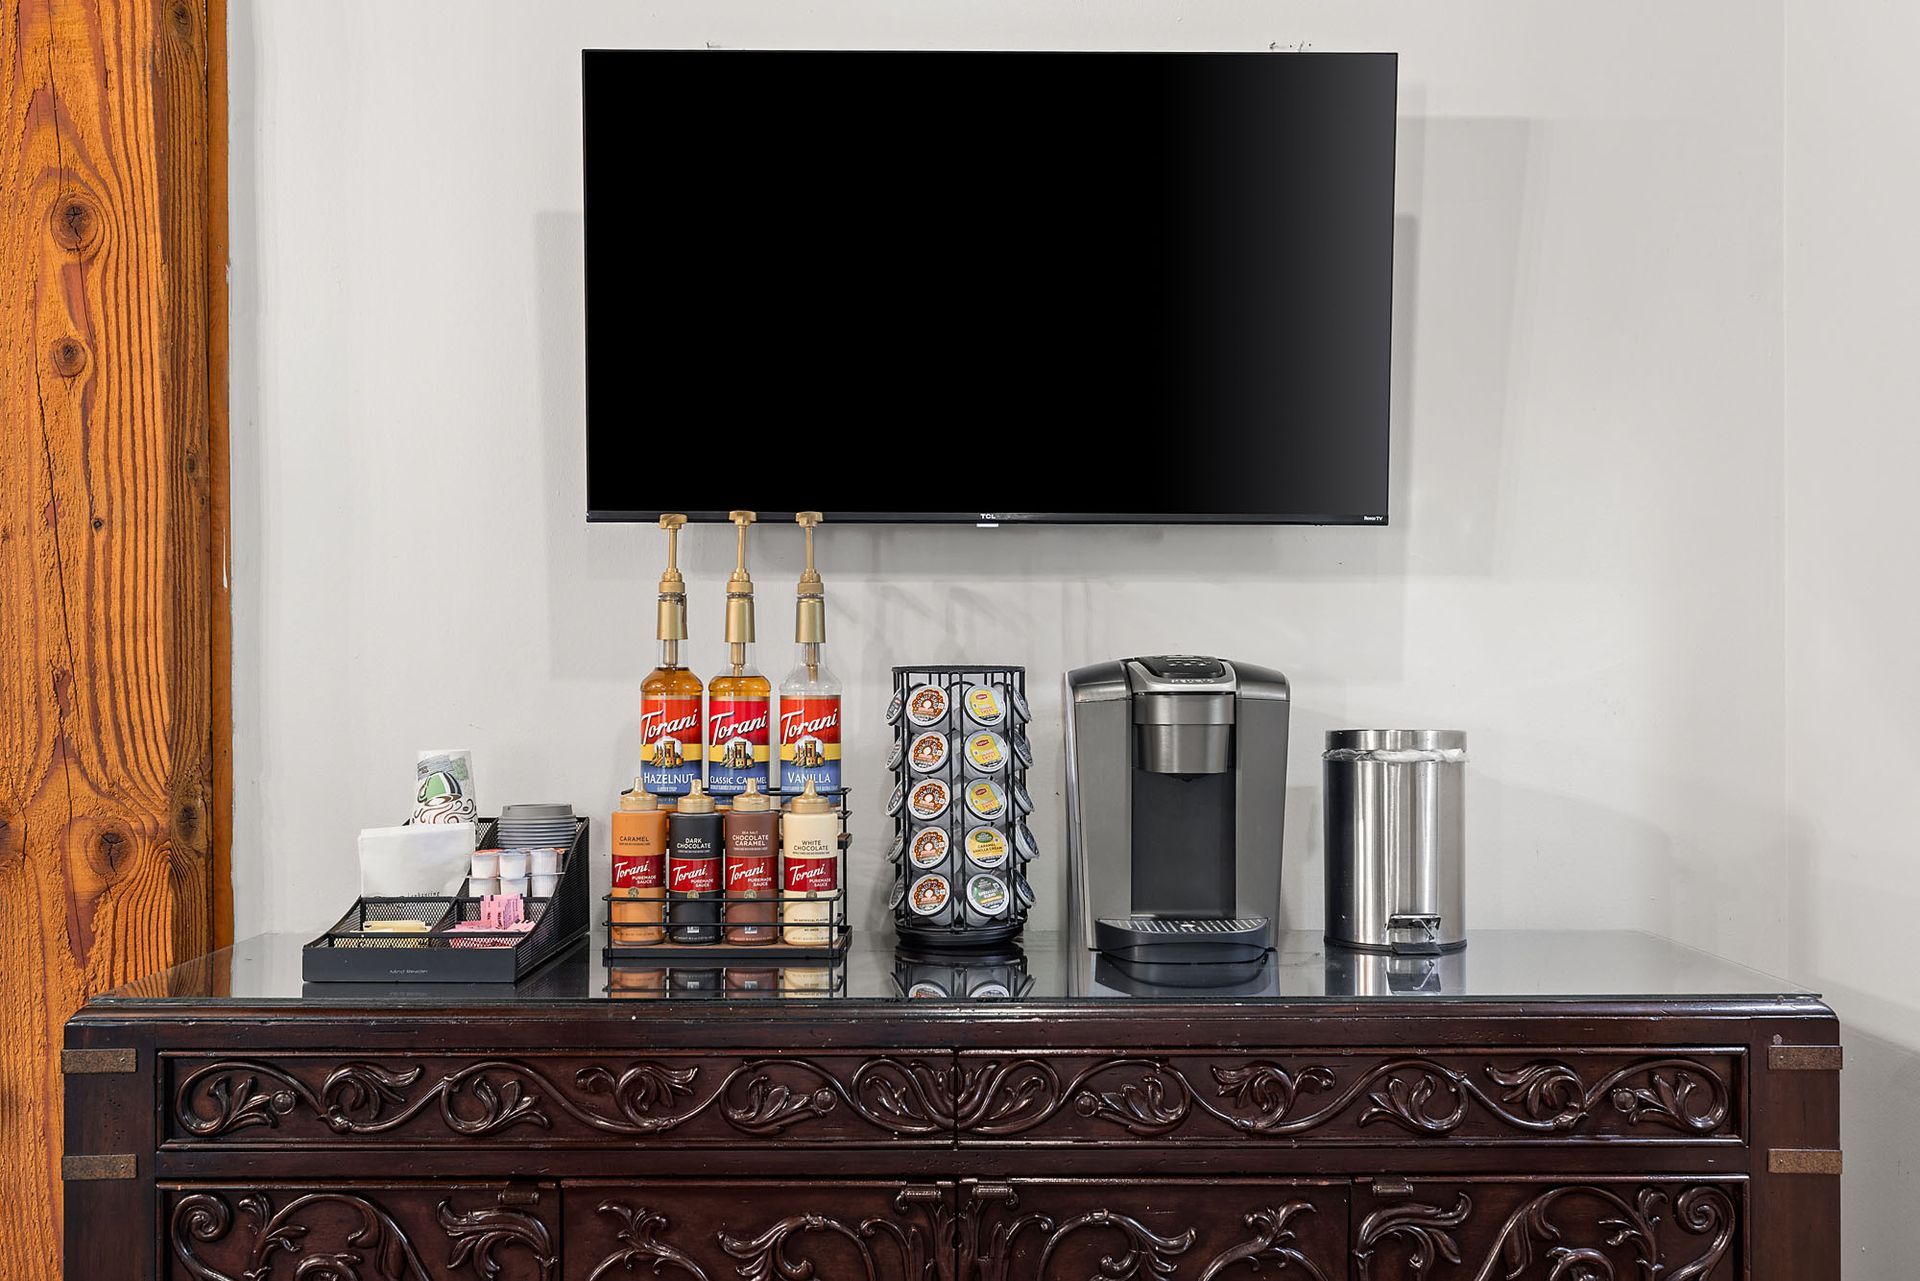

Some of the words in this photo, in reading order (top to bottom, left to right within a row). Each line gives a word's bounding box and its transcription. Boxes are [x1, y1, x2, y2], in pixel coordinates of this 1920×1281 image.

[640, 708, 698, 746] Torani
[709, 710, 768, 747] Torani
[780, 708, 838, 746] Torani
[644, 772, 694, 784] HAZELNUT
[709, 775, 733, 784] CLASSIC
[736, 776, 768, 784] CAMEL
[787, 771, 831, 784] VANILLA
[614, 861, 649, 883] Torani
[672, 864, 707, 886] Torani
[728, 862, 765, 885] Torani
[789, 863, 825, 886] Torani
